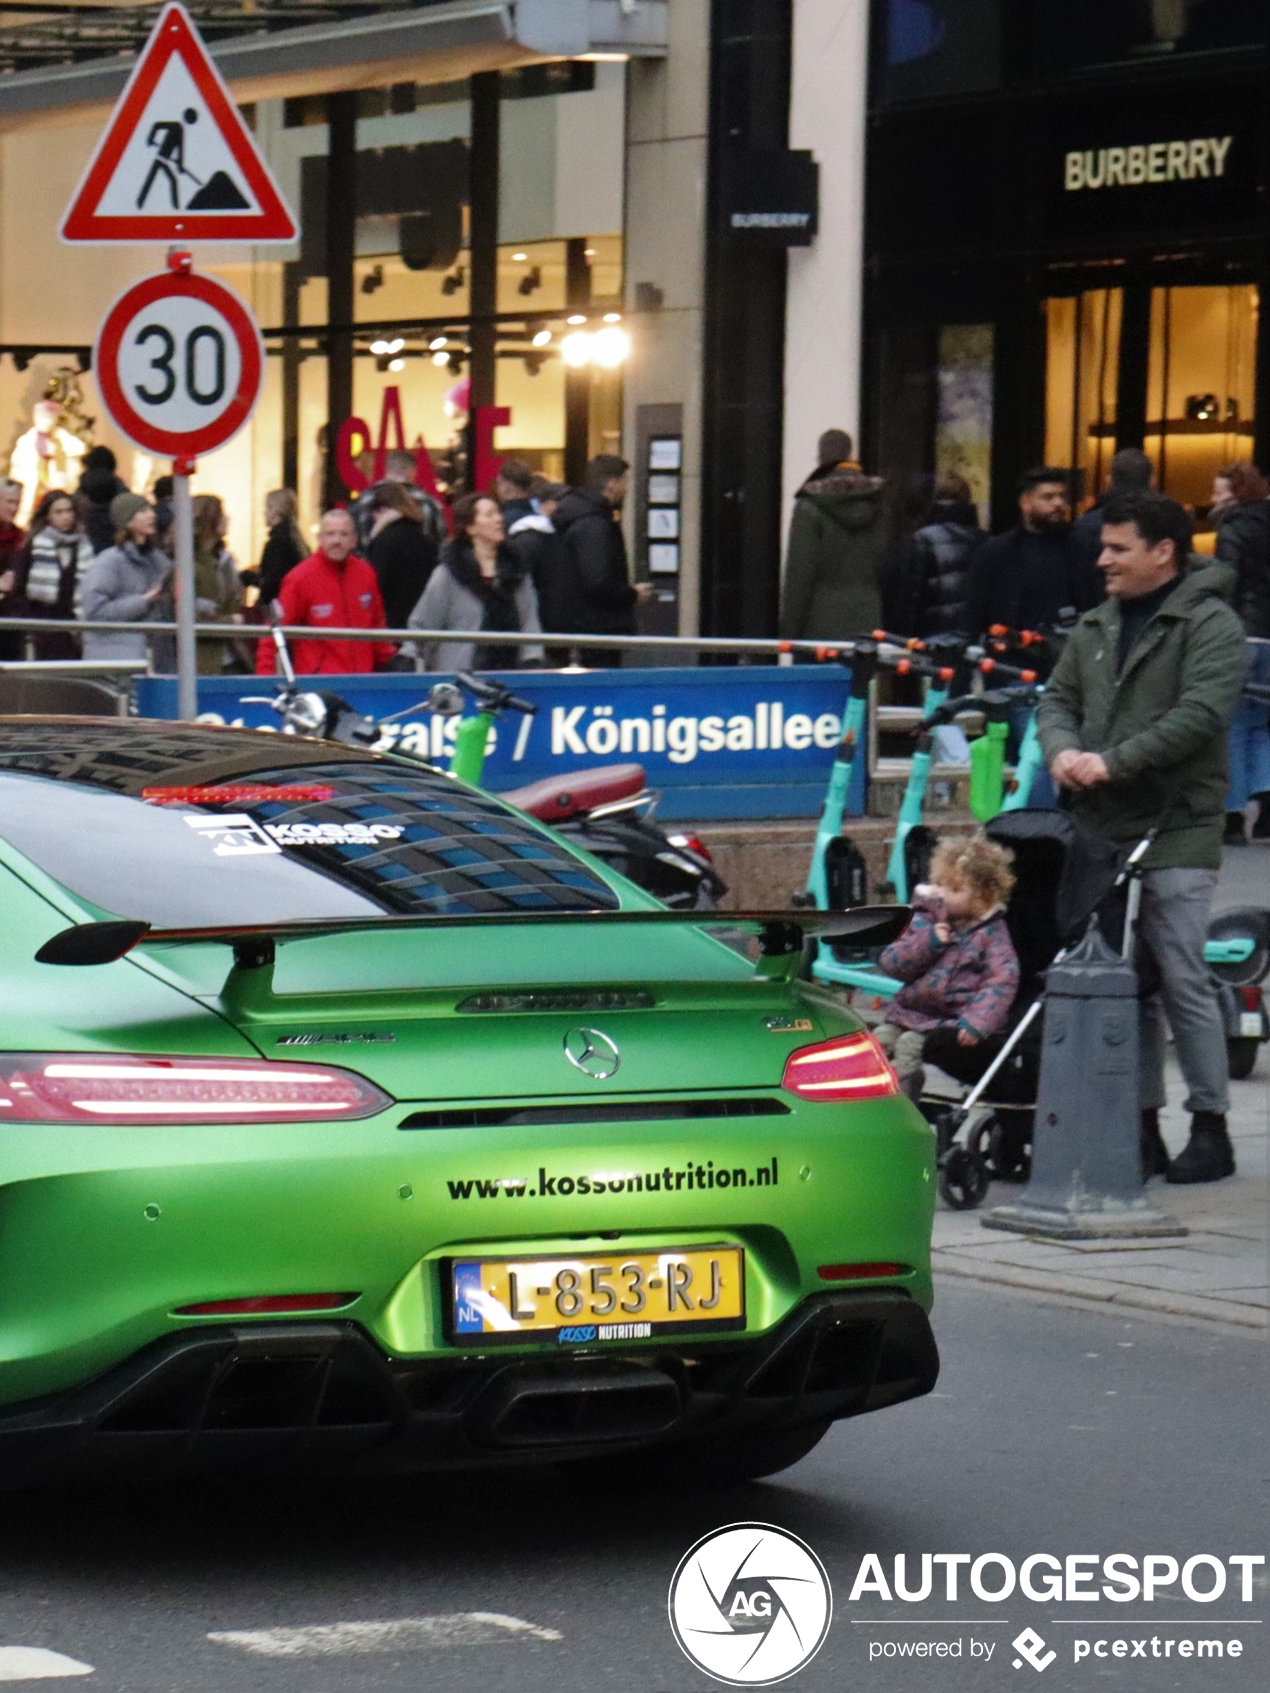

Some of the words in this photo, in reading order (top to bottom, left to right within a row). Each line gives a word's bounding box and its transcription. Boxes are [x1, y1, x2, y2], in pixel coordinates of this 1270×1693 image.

[1064, 136, 1232, 191] BURBERRY
[731, 213, 810, 228] BURBERRY
[134, 324, 225, 406] 30
[551, 702, 841, 764] Königsallee
[263, 824, 401, 838] KOSSO
[447, 1157, 779, 1200] www.kossonutrition.nl
[509, 1260, 720, 1320] L-853-RJ
[459, 1306, 480, 1323] NL
[598, 1322, 652, 1340] NUTRITION
